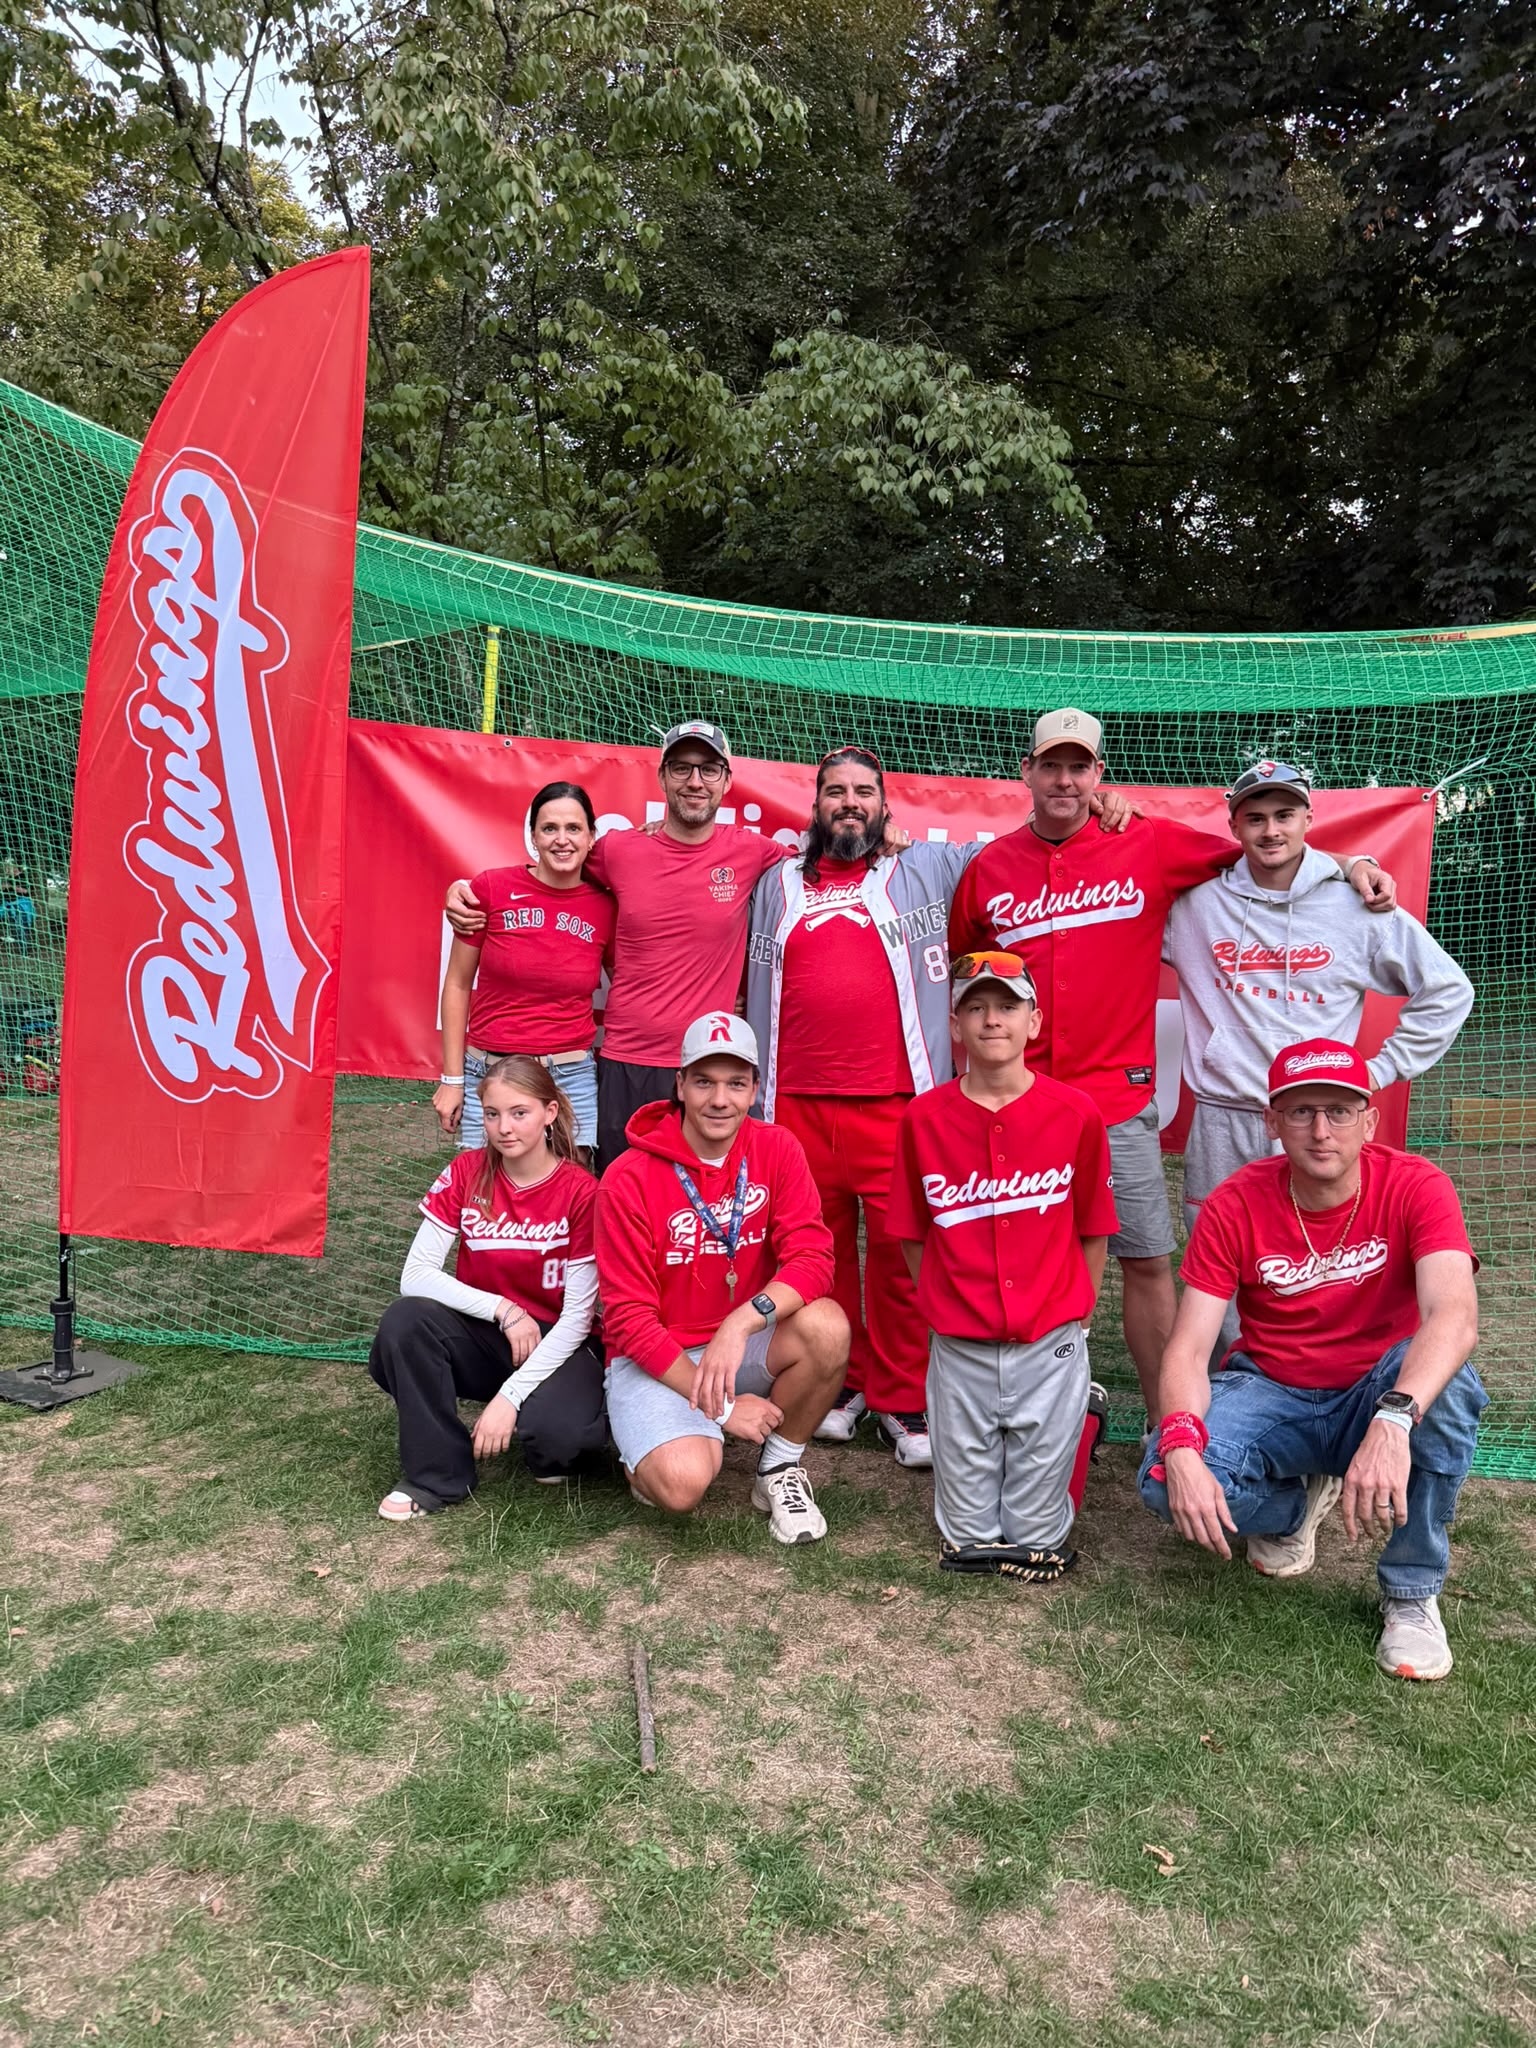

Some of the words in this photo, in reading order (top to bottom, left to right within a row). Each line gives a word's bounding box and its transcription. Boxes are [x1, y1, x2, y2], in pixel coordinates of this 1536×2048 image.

[136, 468, 306, 1083] Redwings
[708, 884, 738, 892] YAKIMA
[712, 891, 735, 899] CHIEF
[503, 908, 545, 930] RED
[556, 912, 596, 942] SOX
[986, 876, 1145, 949] Redwings
[924, 942, 949, 984] 8
[1285, 1051, 1354, 1075] Redwings
[922, 1163, 1075, 1228] Redwings
[460, 1207, 570, 1255] Redwings
[1258, 1238, 1388, 1296] Redwings
